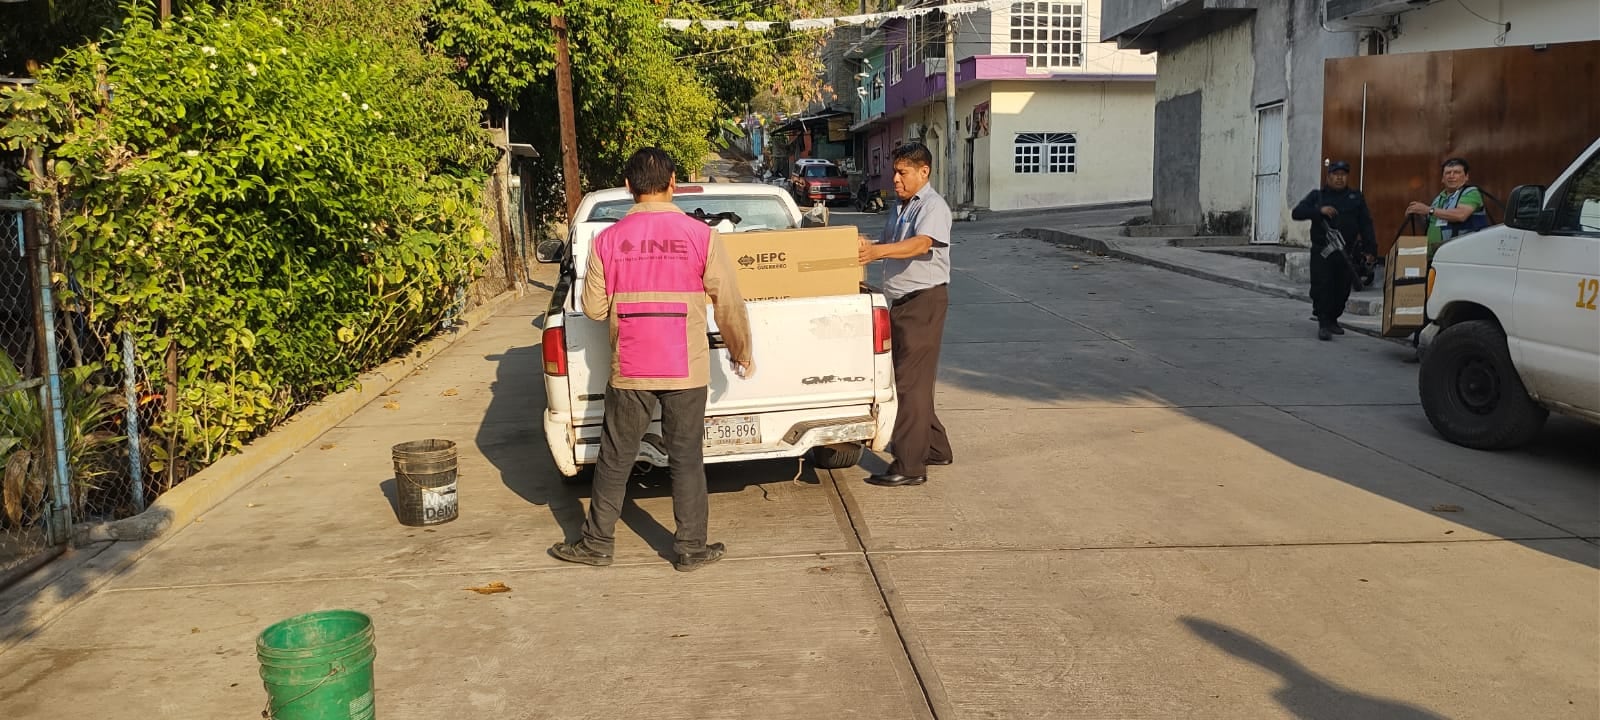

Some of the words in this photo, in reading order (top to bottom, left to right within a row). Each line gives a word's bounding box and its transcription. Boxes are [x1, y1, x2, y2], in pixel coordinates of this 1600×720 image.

[641, 239, 688, 253] INE
[756, 252, 786, 263] IEPC
[1575, 278, 1599, 310] 12
[703, 423, 757, 441] E-58-896
